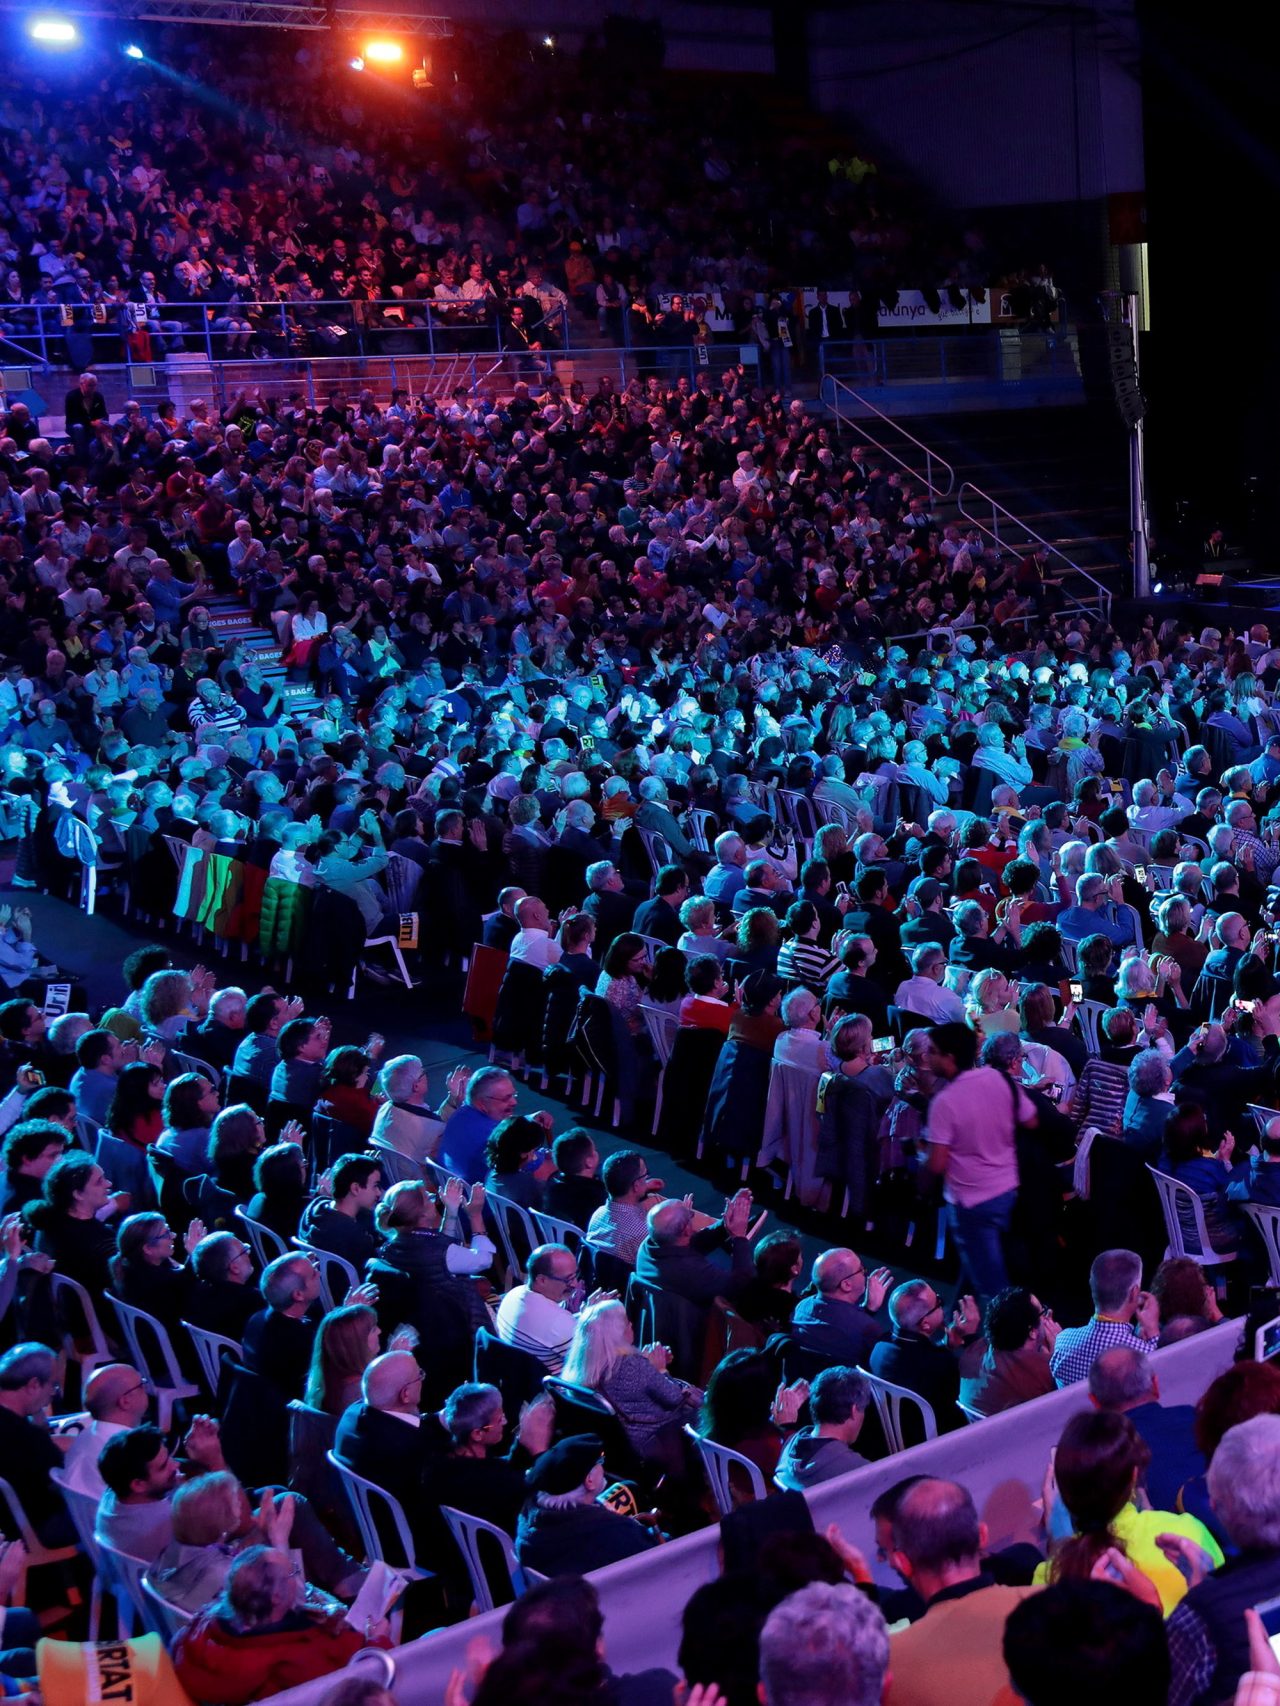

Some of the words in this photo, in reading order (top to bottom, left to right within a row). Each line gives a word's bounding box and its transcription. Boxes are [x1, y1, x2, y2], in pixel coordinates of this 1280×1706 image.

[227, 617, 252, 625] BAGES
[258, 651, 283, 660] BAGES
[96, 1641, 133, 1702] RTAT
